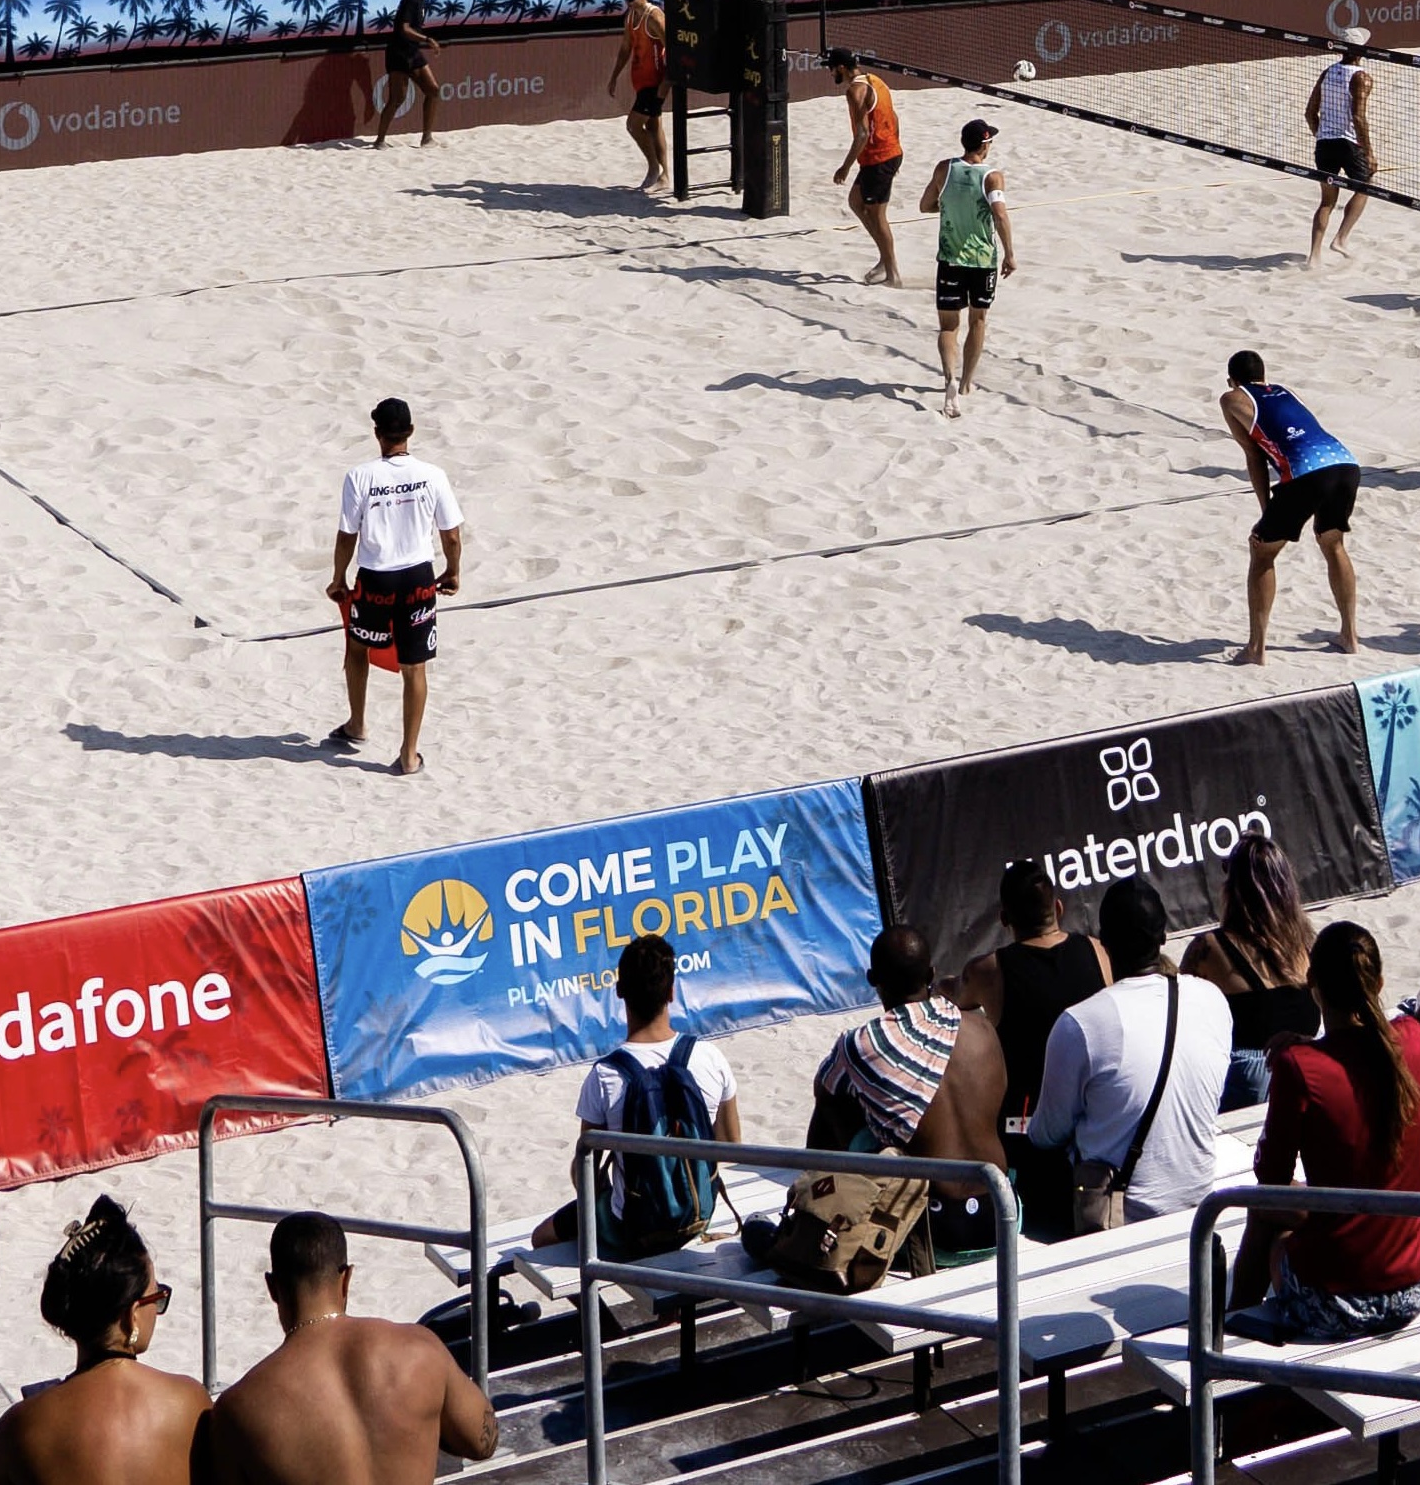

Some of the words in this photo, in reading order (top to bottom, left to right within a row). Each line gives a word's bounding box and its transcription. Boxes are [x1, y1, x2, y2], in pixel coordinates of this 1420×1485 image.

[676, 29, 699, 47] avp
[1077, 20, 1180, 49] vodafone
[439, 72, 545, 101] odafone
[742, 67, 762, 88] avp
[48, 101, 181, 134] vodafone
[395, 480, 427, 495] COURT
[504, 846, 656, 914] COME
[666, 822, 789, 885] PLAY
[509, 915, 562, 967] IN
[572, 874, 798, 955] FLORIDA
